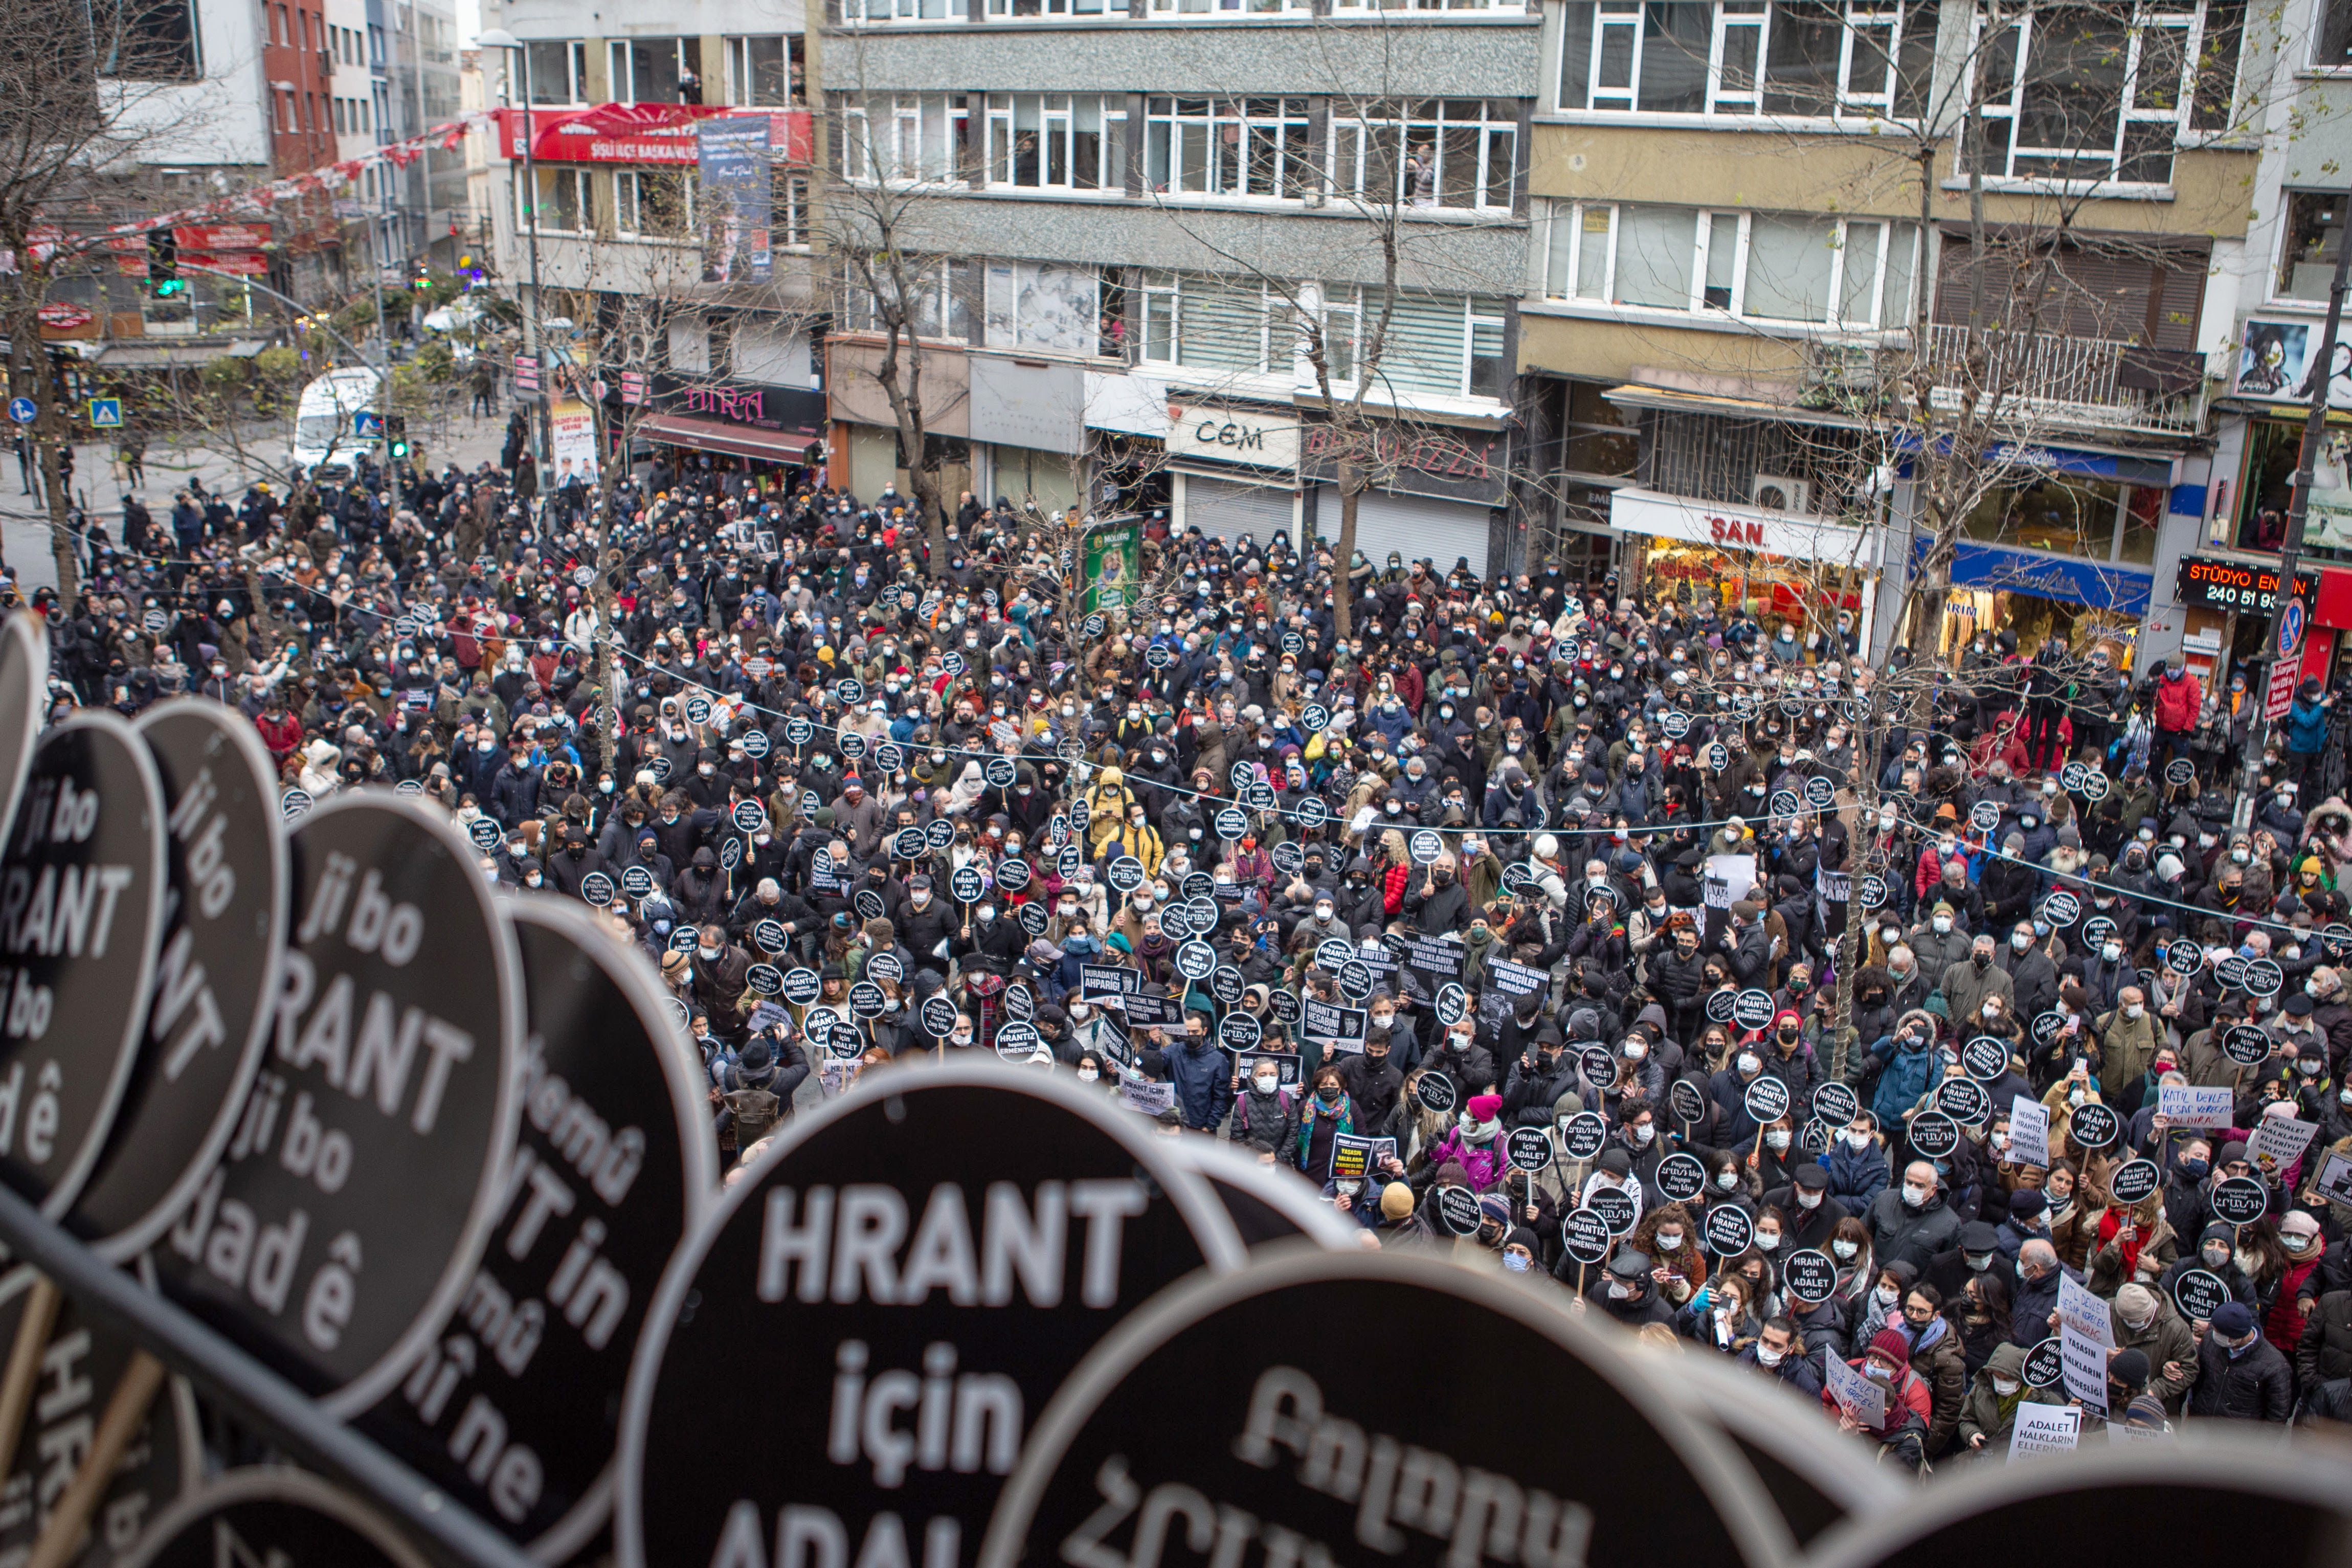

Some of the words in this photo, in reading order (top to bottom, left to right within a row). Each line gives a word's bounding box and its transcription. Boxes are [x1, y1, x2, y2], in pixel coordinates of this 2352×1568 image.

[1196, 420, 1263, 451] CEM
[1588, 491, 1611, 505] EME
[2190, 564, 2251, 587] STÜDYO
[2258, 575, 2306, 595] ENİN
[2207, 585, 2236, 603] 240
[2241, 590, 2256, 606] 51
[54, 775, 99, 844] bo
[473, 821, 493, 831] HRANT
[929, 826, 951, 835] HRANT
[1594, 888, 1611, 897] HRANT
[296, 850, 357, 944] ji
[346, 867, 424, 968] bo
[1026, 905, 1045, 917] HRANT
[1420, 935, 1448, 947] YAŞASIN
[1188, 943, 1212, 956] HRANT
[1362, 951, 1390, 962] MUTLU
[1405, 939, 1437, 954] İŞÇİLERİN
[1438, 948, 1463, 959] BİRLİĞİ
[2172, 945, 2198, 961] HRANT
[1182, 958, 1208, 970] ADALET
[1413, 949, 1454, 965] HALKLARIN
[870, 961, 900, 972] HRANTIZ
[1488, 957, 1527, 974] KATİLLERDEN
[785, 976, 816, 987] HRANTIZ
[1085, 970, 1119, 980] BURADAYIZ
[1494, 968, 1539, 990] EMEKÇİLER
[1085, 976, 1120, 992] AHPARİG!
[1738, 998, 1771, 1010] HRANTIZ
[808, 1014, 837, 1030] HRANT
[1307, 1011, 1340, 1029] HESABINI
[1735, 1011, 1769, 1022] ERMENİYİZ!
[834, 1025, 857, 1035] HRANT
[1000, 1033, 1035, 1042] HRANTIZ
[2236, 1028, 2264, 1041] HRANT
[269, 945, 477, 1136] RANT
[832, 1041, 857, 1050] ADALET
[2241, 1037, 2254, 1047] için
[1587, 1052, 1609, 1062] HRANT
[1974, 1042, 1997, 1062] HRANT
[2229, 1043, 2261, 1058] ADALET
[1587, 1068, 1611, 1078] ADALET
[1123, 1080, 1149, 1092] HRANT
[1944, 1085, 1969, 1100] HRANT
[1752, 1084, 1786, 1104] HRANTIZ
[1819, 1089, 1854, 1111] HRANTIZ
[2161, 1088, 2190, 1104] KATİL
[2196, 1092, 2230, 1103] DEVLET
[1746, 1097, 1781, 1117] ERMENİYİZ!
[2018, 1109, 2043, 1124] HEPİMİZ
[2078, 1112, 2112, 1129] HRANT
[228, 1068, 288, 1162] ji
[279, 1090, 353, 1195] bo
[2015, 1119, 2042, 1134] HRANTIZ
[2077, 1128, 2095, 1140] dad
[2273, 1122, 2305, 1134] ADALET
[1516, 1133, 1544, 1143] HRANT
[2014, 1129, 2041, 1144] HEPİMİZ
[2260, 1126, 2310, 1143] HALKLARIN
[1523, 1143, 1536, 1151] için
[2260, 1135, 2302, 1150] ELLERİYLE
[1513, 1150, 1545, 1160] ADALET
[2258, 1144, 2295, 1157] GELECEK!
[1521, 1159, 1537, 1168] için!
[2118, 1173, 2143, 1182] HRANT
[1568, 1220, 1606, 1236] HRANTIZ
[1713, 1215, 1740, 1231] HRANT
[754, 1178, 1150, 1309] HRANT
[1575, 1233, 1597, 1241] hepimiz
[1564, 1237, 1605, 1253] ERMENİYİZ!
[1794, 1257, 1825, 1266] HRANT
[1802, 1268, 1818, 1277] için
[546, 1216, 630, 1351] in
[1794, 1278, 1829, 1287] ADALET
[2187, 1275, 2217, 1290] HRANT
[301, 1229, 365, 1355] ê
[1803, 1288, 1821, 1297] için!
[2194, 1286, 2209, 1297] için
[2081, 1293, 2106, 1315] DEVLET
[2183, 1291, 2217, 1310] ADALET
[2068, 1336, 2097, 1359] YAŞASIN
[2043, 1352, 2056, 1365] için
[2063, 1352, 2101, 1380] HALKLARIN
[2029, 1358, 2058, 1378] ADALET
[2029, 1371, 2046, 1383] için!
[2063, 1369, 2103, 1398] KARDEŞLİĞİ
[1849, 1374, 1880, 1398] DEVLET
[825, 1337, 1025, 1490] için
[2027, 1420, 2070, 1432] ADALET
[2019, 1429, 2074, 1445] HALKLARIN
[446, 1393, 545, 1525] ne
